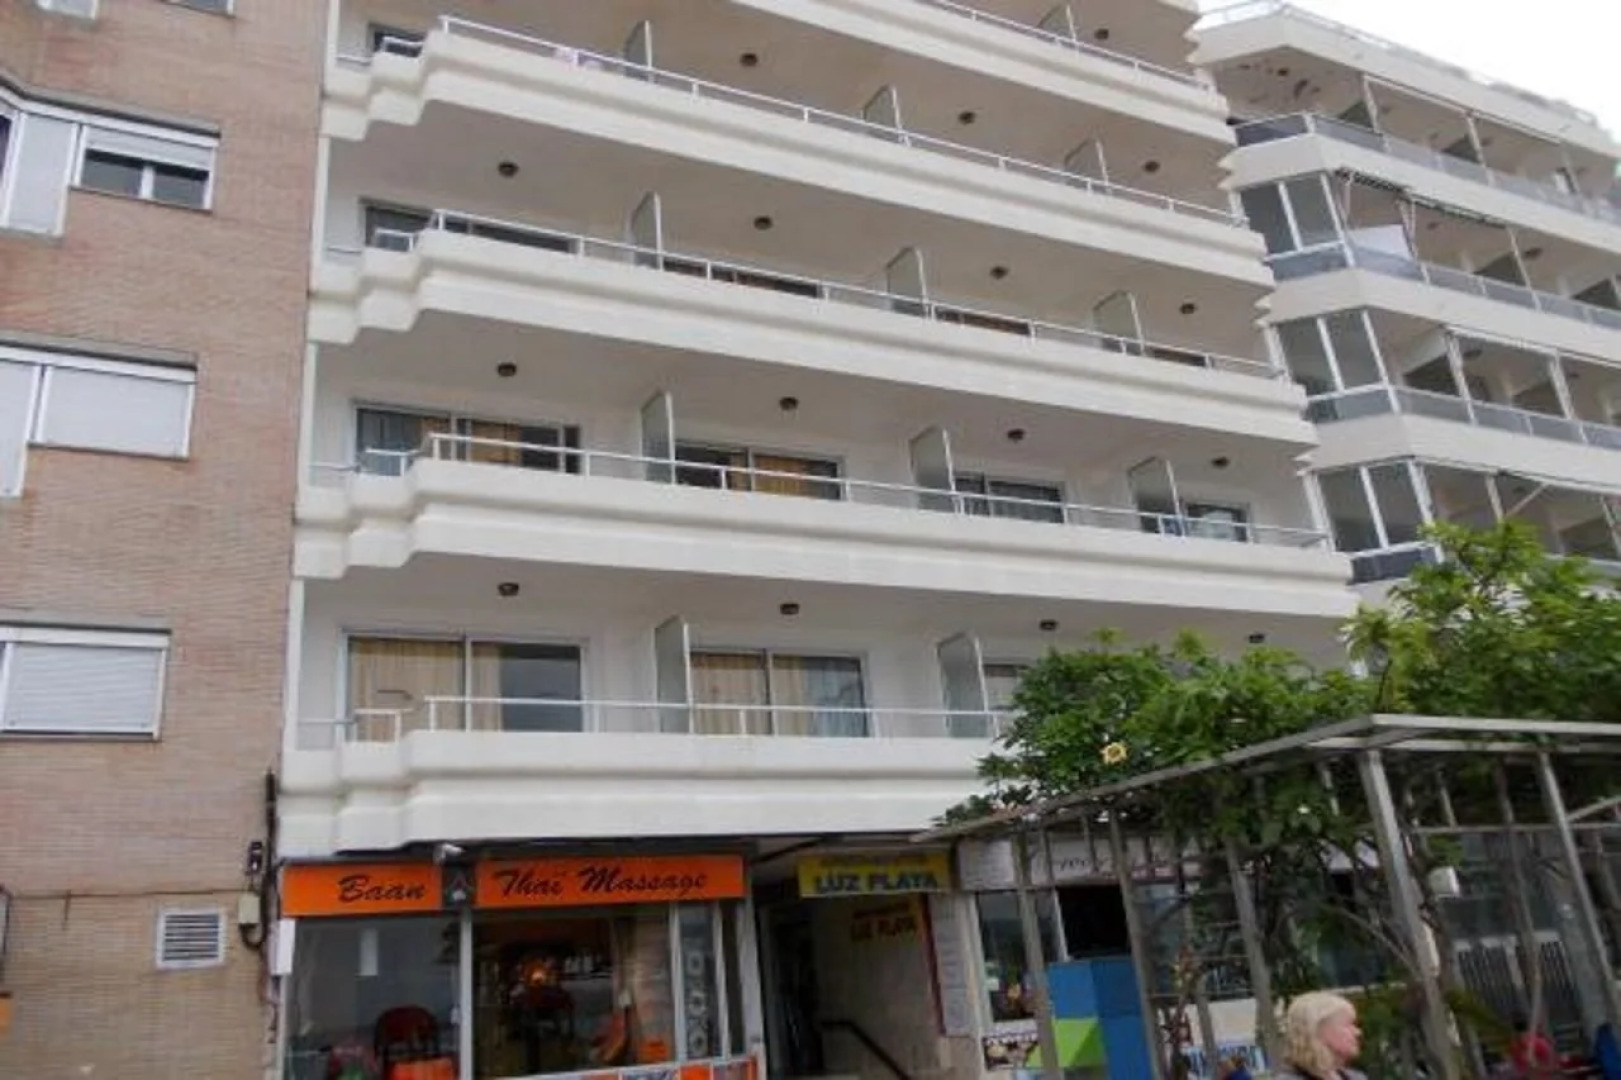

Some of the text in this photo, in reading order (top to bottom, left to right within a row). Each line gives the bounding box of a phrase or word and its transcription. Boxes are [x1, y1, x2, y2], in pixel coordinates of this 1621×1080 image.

[338, 875, 425, 902] Baan
[578, 865, 707, 896] Massage
[814, 874, 860, 893] LUZ
